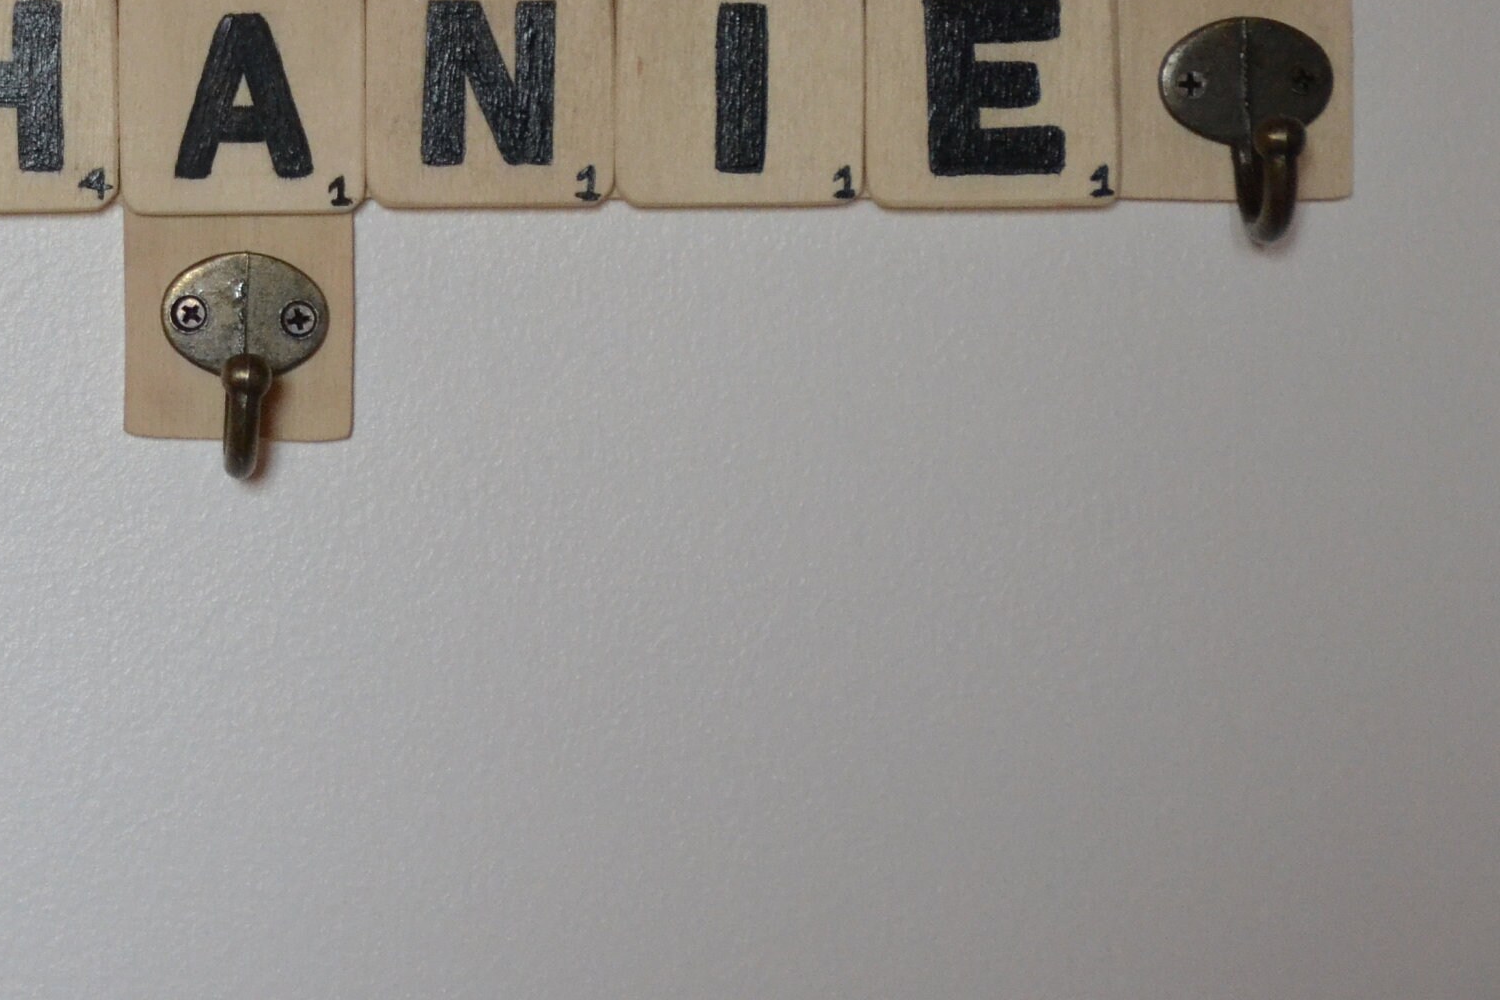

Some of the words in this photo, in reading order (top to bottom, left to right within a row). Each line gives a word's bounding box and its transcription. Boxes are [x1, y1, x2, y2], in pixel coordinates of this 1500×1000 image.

[77, 167, 114, 201] 4
[328, 175, 354, 207] 1
[574, 164, 602, 202] 1
[833, 165, 859, 201] 1
[1088, 164, 1115, 199] 1
